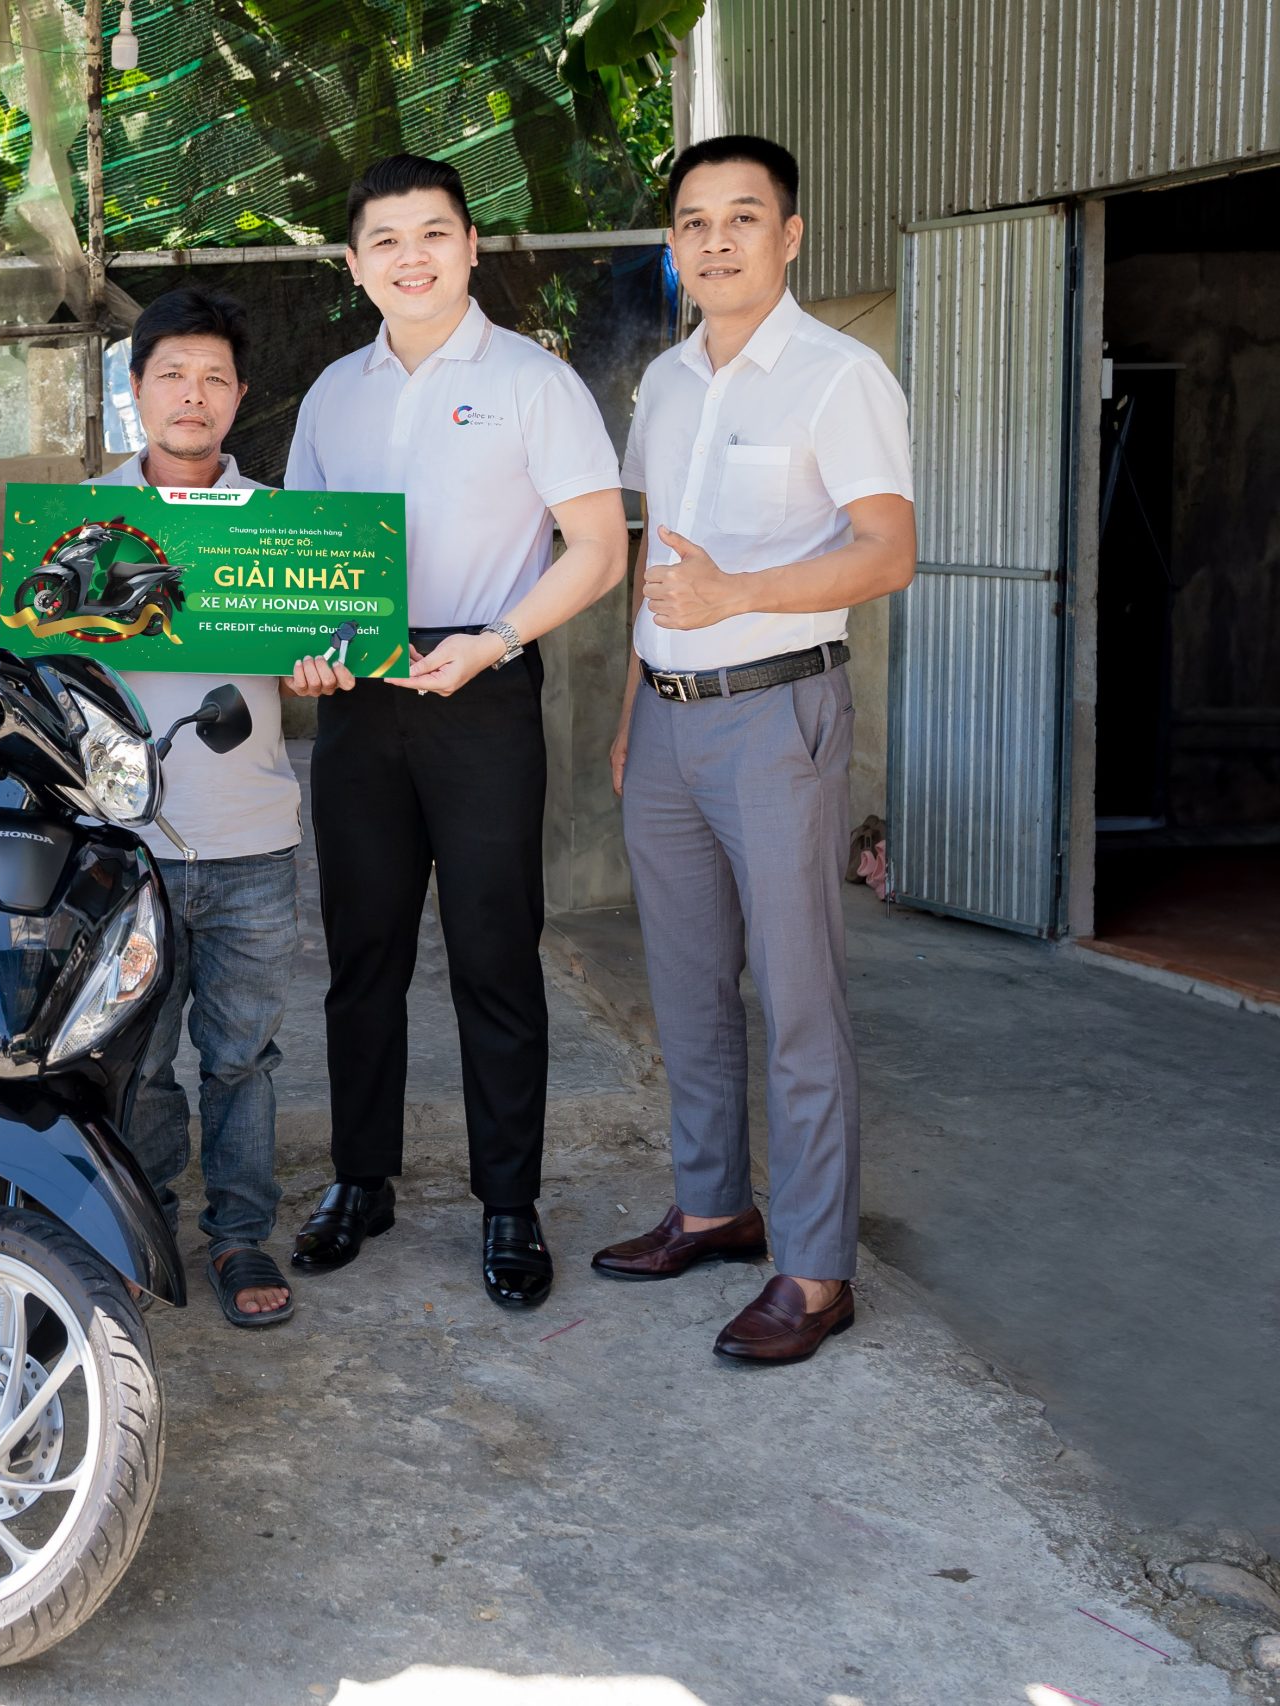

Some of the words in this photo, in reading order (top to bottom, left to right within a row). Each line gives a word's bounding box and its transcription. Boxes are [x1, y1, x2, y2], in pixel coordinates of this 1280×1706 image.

[169, 492, 187, 500] FE
[189, 493, 241, 501] CREDIT
[229, 526, 258, 535] Chương
[259, 527, 277, 535] trình
[278, 527, 287, 535] tri
[299, 528, 322, 536] khách
[323, 529, 343, 537] hàng
[259, 536, 272, 545] HÈ
[274, 538, 294, 548] RỰC
[197, 547, 231, 555] THANH
[233, 545, 260, 556] TOÁN
[262, 548, 289, 556] NGAY
[296, 549, 313, 557] VUI
[315, 547, 328, 557] HÈ
[330, 550, 351, 558] MAY
[353, 547, 376, 559] MẮN
[214, 560, 274, 588] GIẢI
[285, 562, 365, 590] NHẤT
[200, 596, 221, 609] XE
[225, 594, 258, 609] MÁY
[262, 598, 320, 611] HONDA
[324, 599, 378, 613] VISION
[198, 622, 212, 631] FE
[214, 622, 256, 632] CREDIT
[258, 623, 284, 633] chúc
[286, 624, 316, 636] mừng
